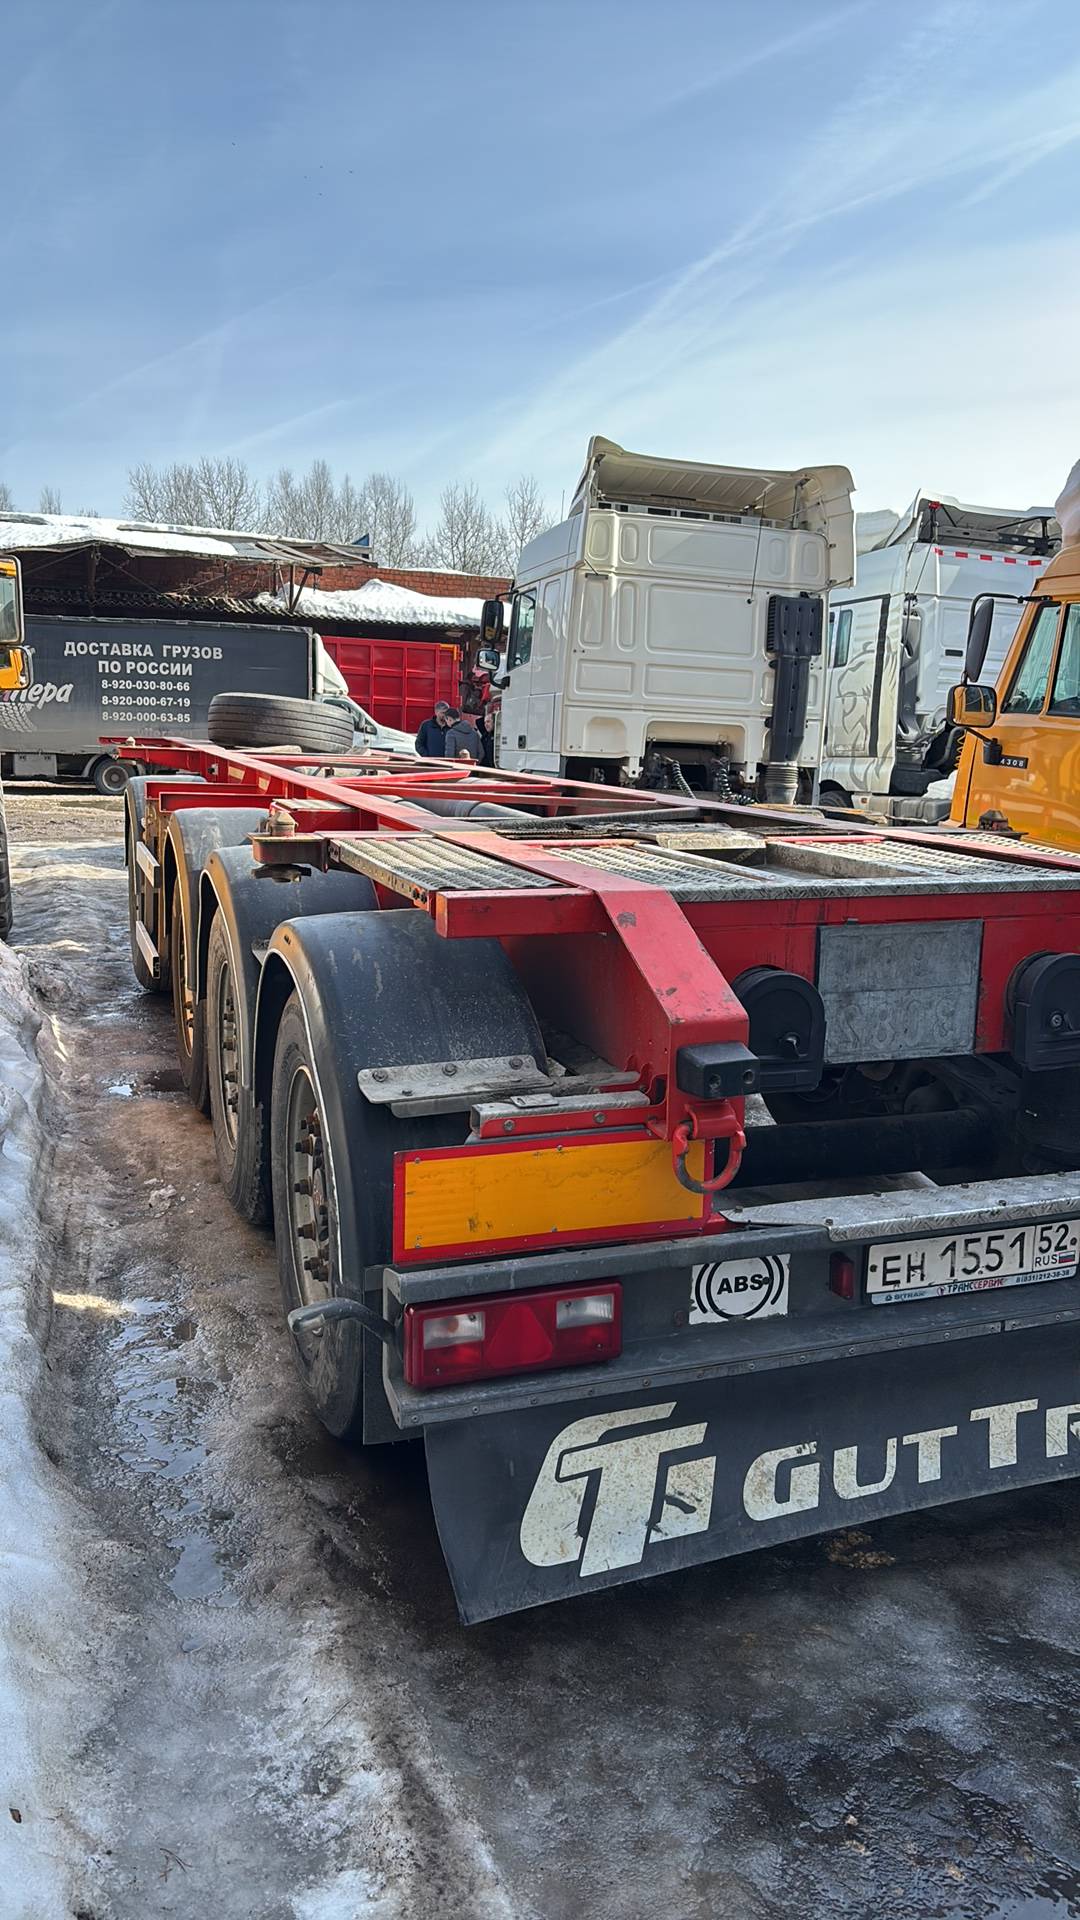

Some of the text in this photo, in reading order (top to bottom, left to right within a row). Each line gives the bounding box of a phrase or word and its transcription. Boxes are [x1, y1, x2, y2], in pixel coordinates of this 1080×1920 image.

[63, 641, 223, 660] ДОСТАВКА ГРУЗОВ
[98, 660, 193, 676] ПО РОССИИ
[101, 679, 190, 692] 8-920-030-80-66
[101, 695, 191, 708] 8-920-000-67-19
[102, 711, 191, 723] 8-920-000-63-85
[881, 1223, 1069, 1287] ЕН 1551 52
[1034, 1254, 1058, 1268] RUS
[717, 1273, 763, 1296] ABS
